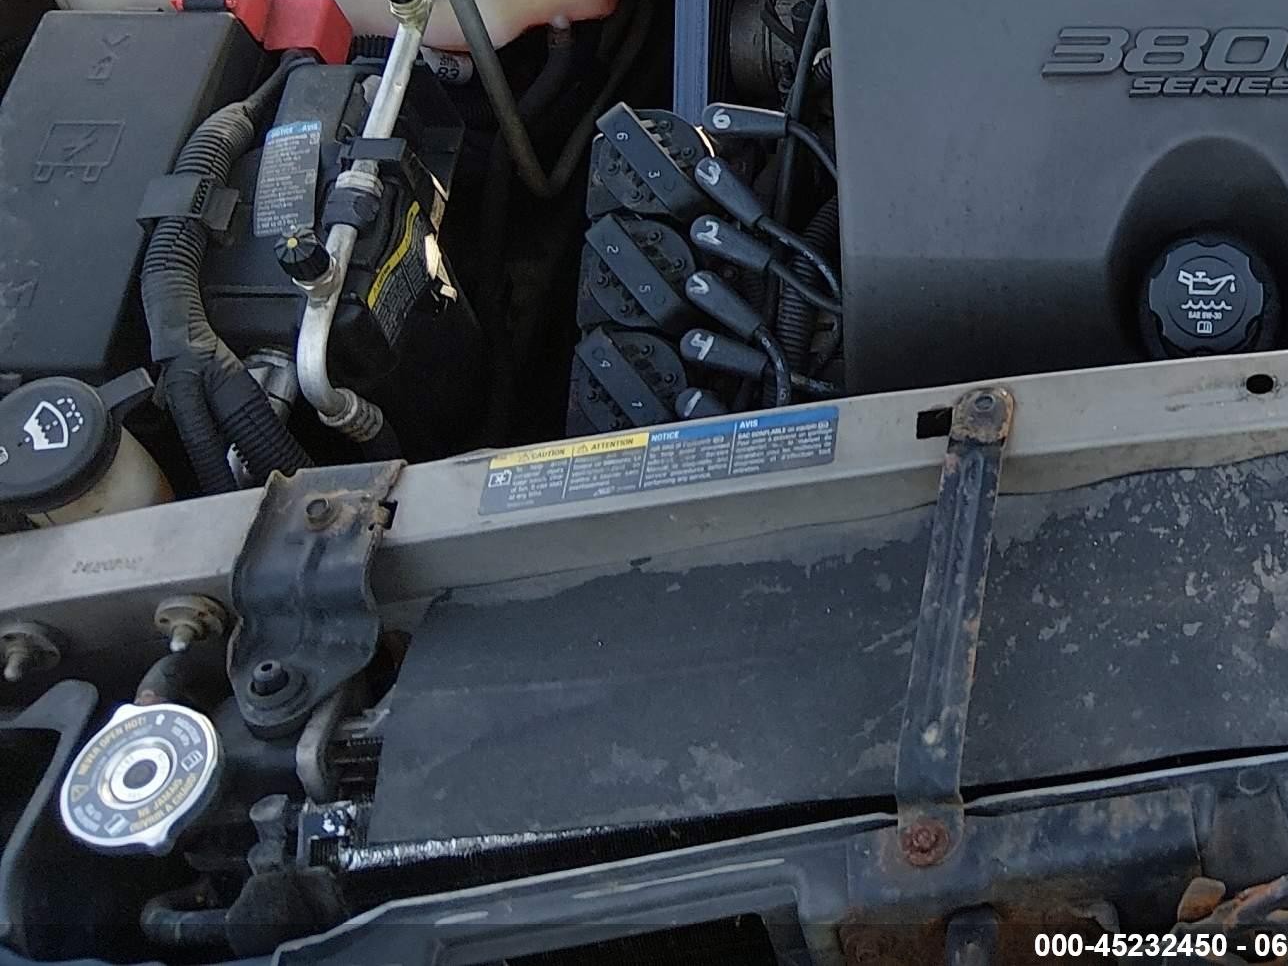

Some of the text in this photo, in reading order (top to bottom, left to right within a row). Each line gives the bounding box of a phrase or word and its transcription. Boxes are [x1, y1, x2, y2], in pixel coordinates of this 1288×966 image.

[712, 108, 731, 129] 6
[648, 169, 661, 179] 3
[696, 220, 722, 245] 2
[606, 245, 620, 254] 2
[690, 332, 715, 361] 4
[739, 418, 759, 430] AVIS
[650, 430, 680, 443] NOTICE
[590, 437, 634, 452] ATTENTION
[529, 448, 566, 461] CAUTION
[99, 727, 123, 747] OPEN
